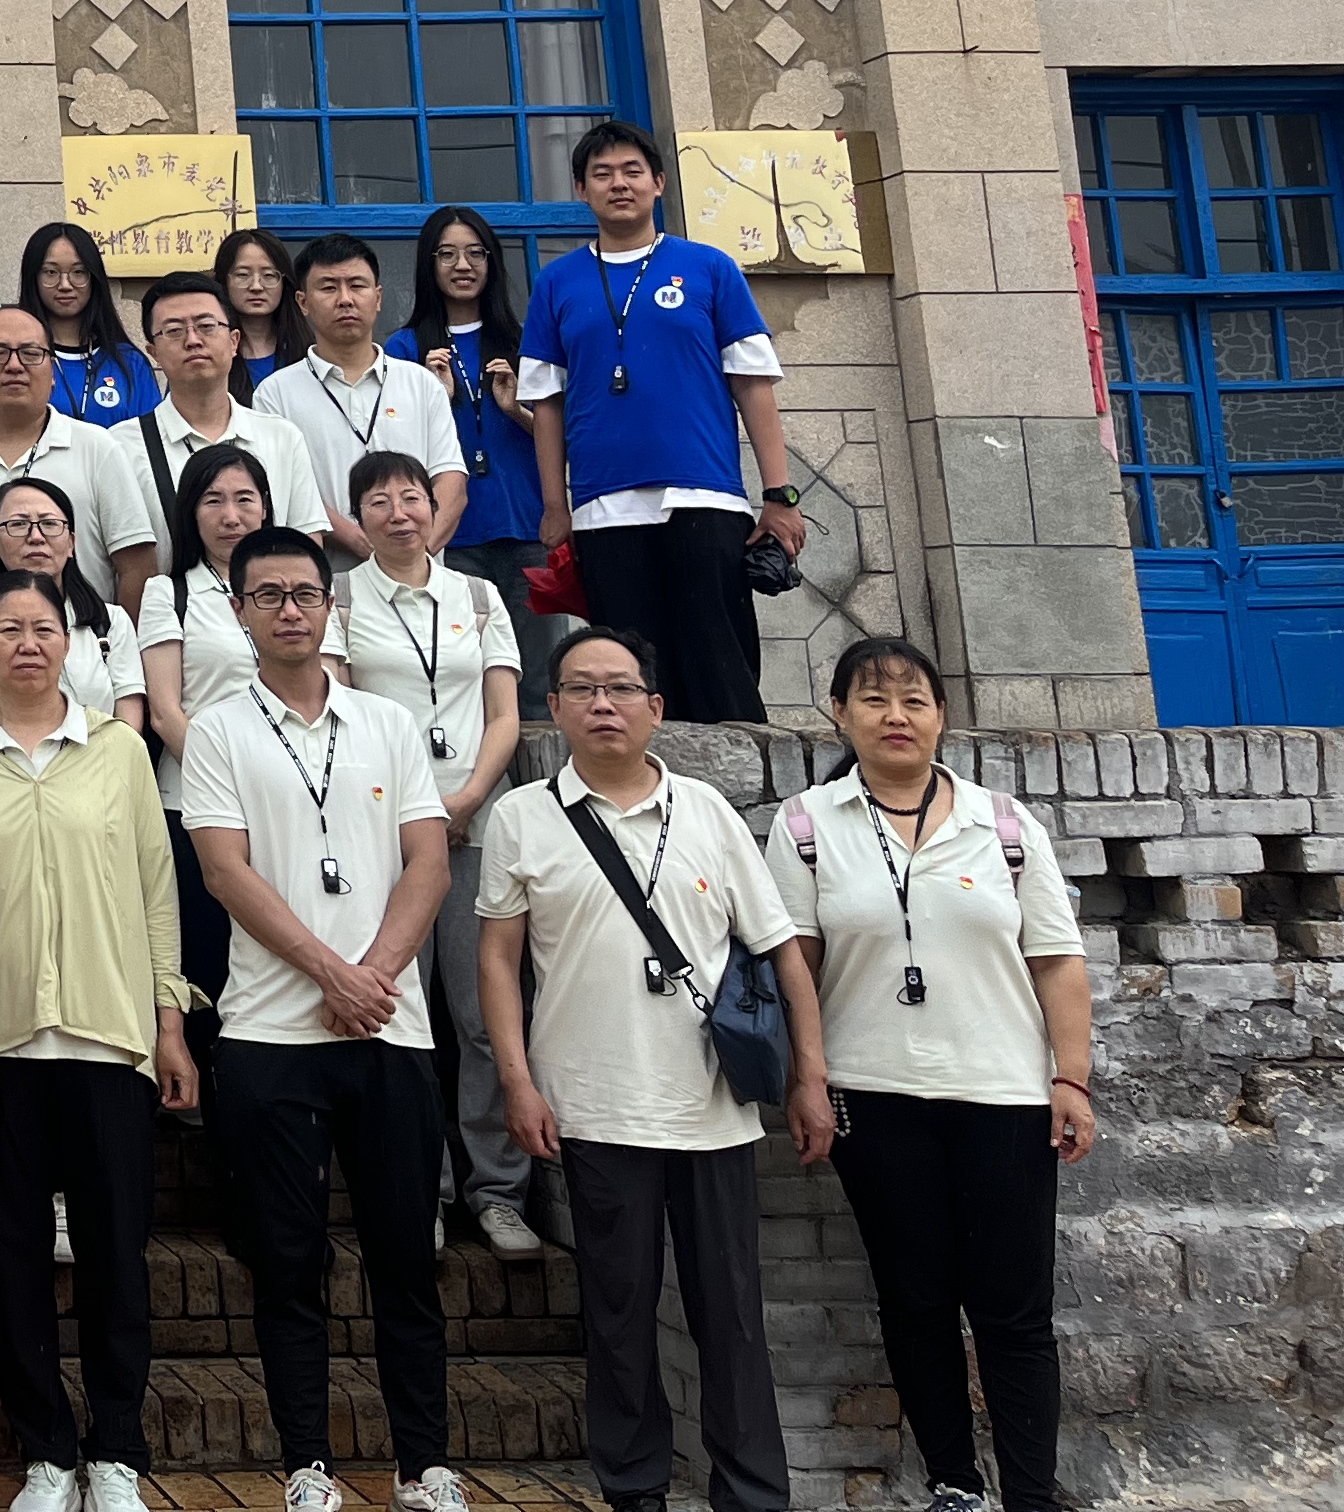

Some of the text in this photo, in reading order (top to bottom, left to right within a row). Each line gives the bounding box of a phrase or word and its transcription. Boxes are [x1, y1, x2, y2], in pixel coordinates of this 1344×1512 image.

[88, 229, 227, 255] 党性教育教学
